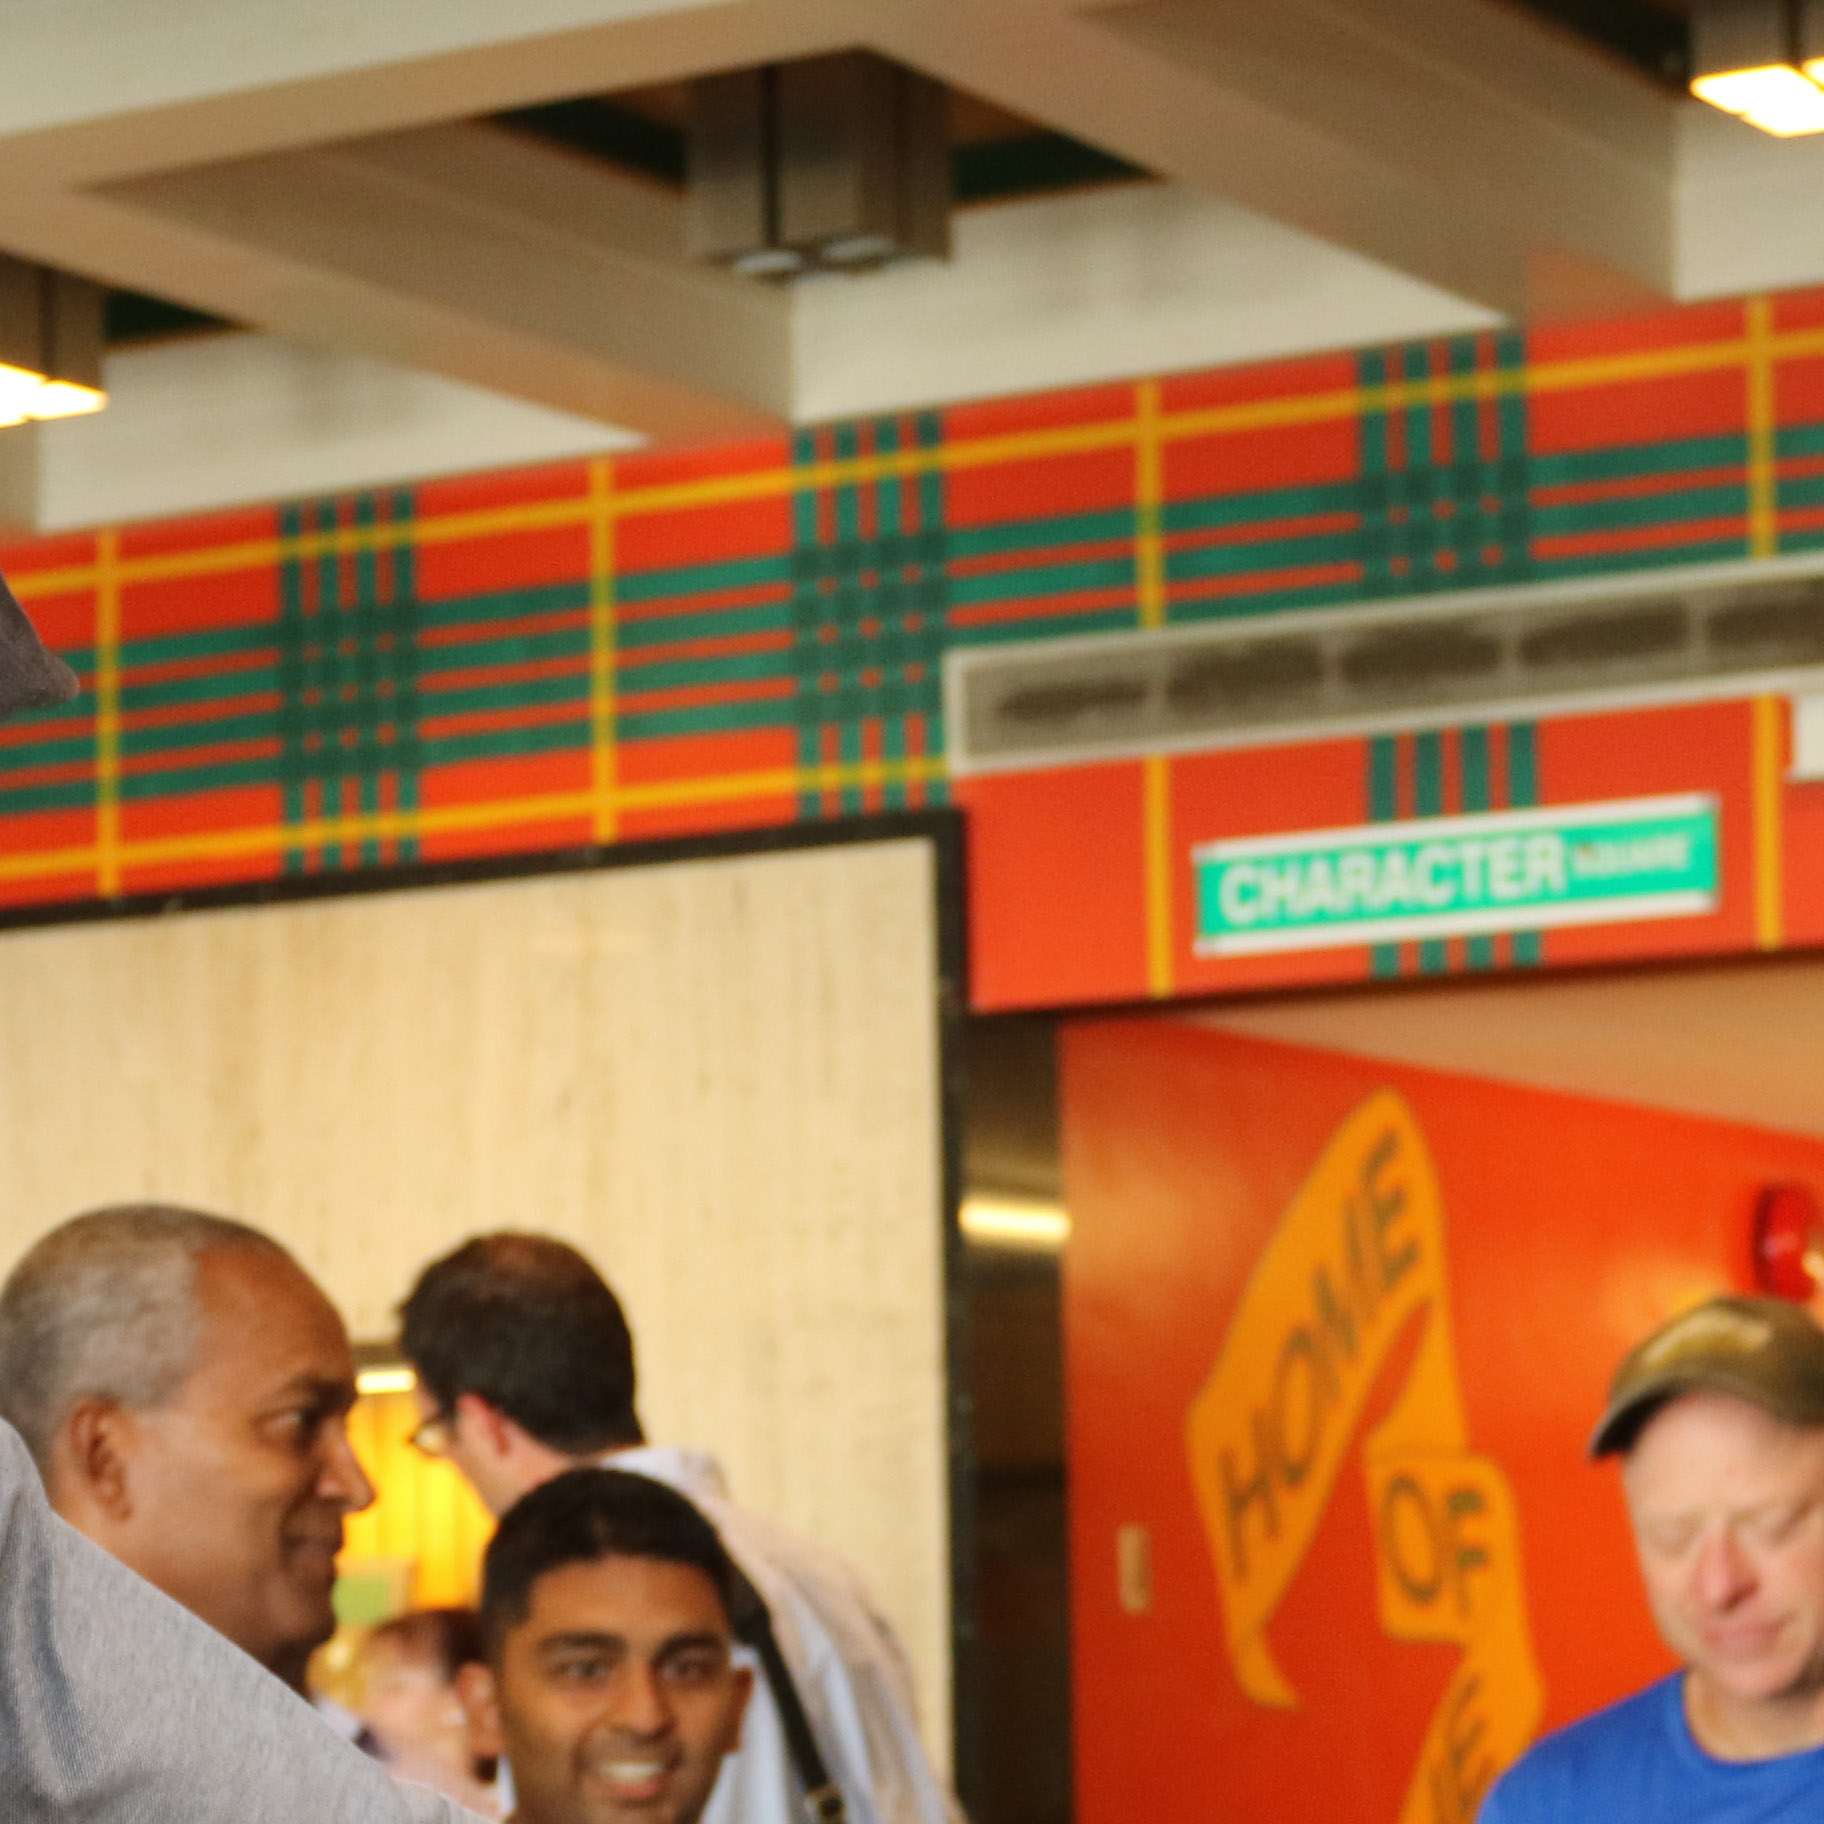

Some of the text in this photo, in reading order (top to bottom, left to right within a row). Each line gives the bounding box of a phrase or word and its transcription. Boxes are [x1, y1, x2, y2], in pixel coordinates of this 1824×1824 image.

[1218, 833, 1568, 926] CHARACTER
[1218, 1130, 1422, 1584] HOME
[1383, 1474, 1490, 1620] OF
